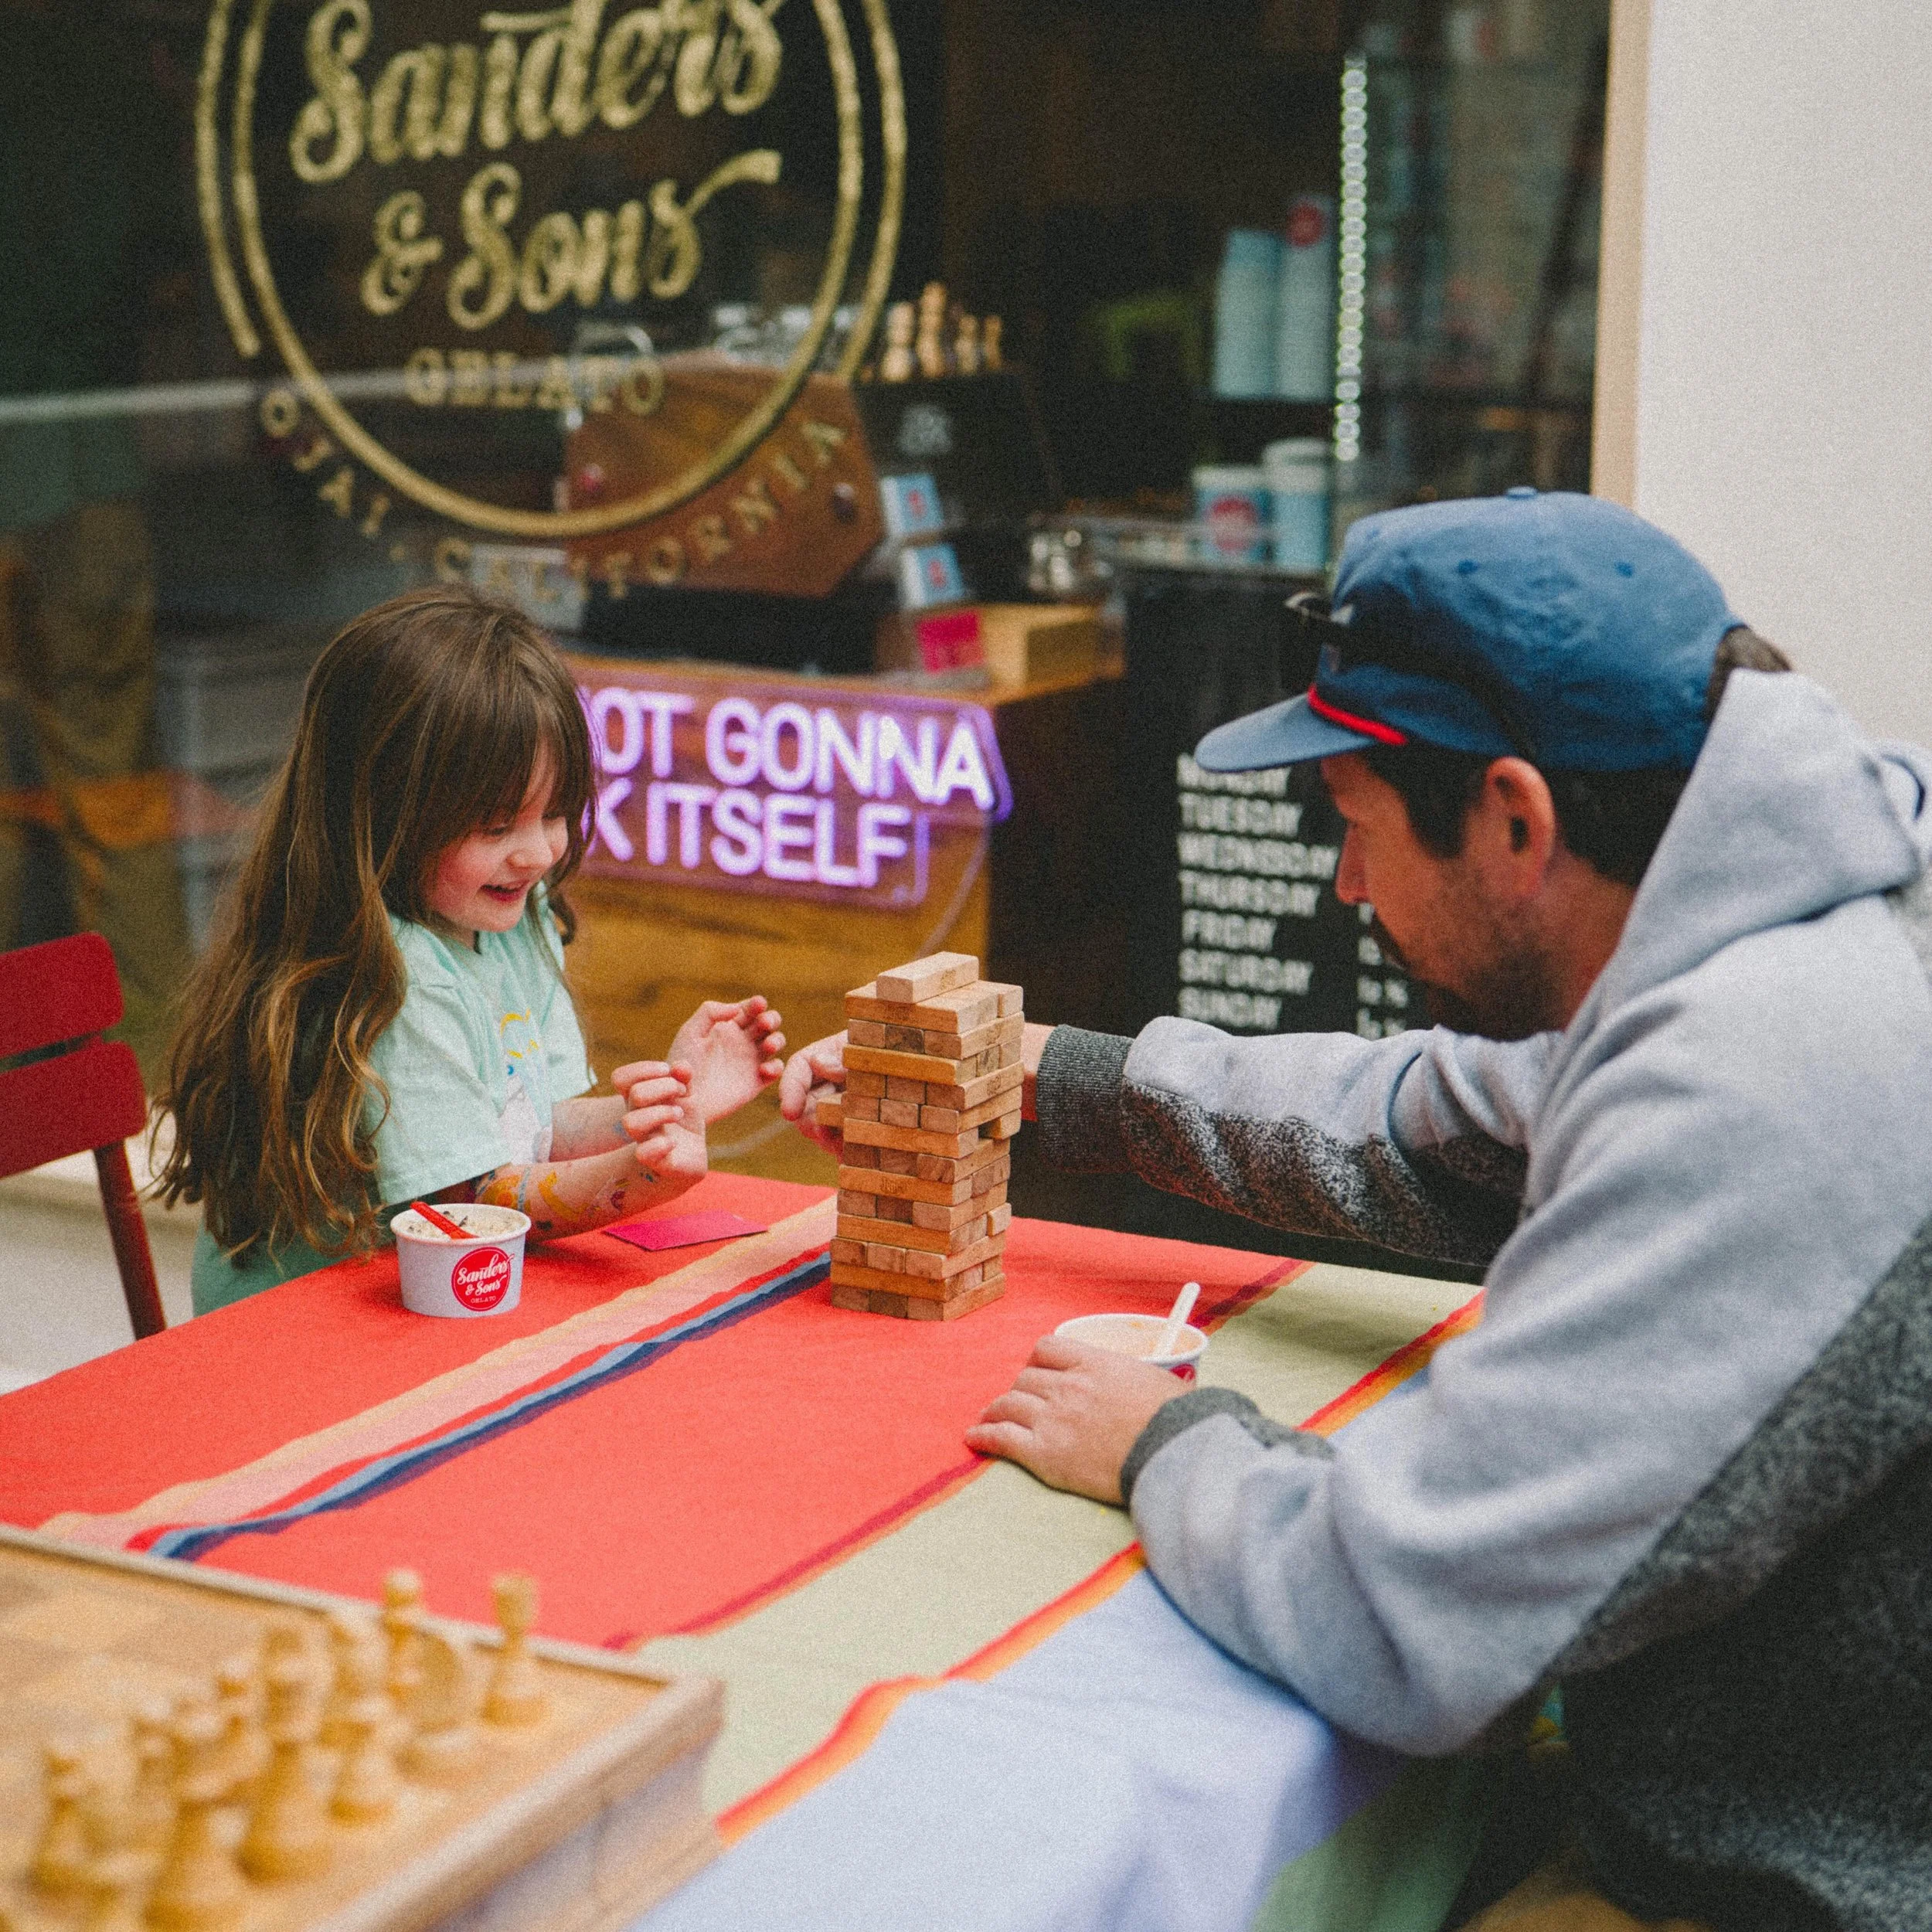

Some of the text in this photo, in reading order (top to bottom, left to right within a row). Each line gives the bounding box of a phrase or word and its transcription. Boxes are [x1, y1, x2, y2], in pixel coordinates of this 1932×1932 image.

[288, 0, 782, 182] Sanders
[361, 149, 781, 330] & Sons
[405, 349, 663, 415] GELATO
[578, 685, 995, 811] OT GONNA
[646, 781, 913, 888] ITSELF
[457, 1254, 514, 1284] Sanders
[466, 1276, 507, 1295] & Sons
